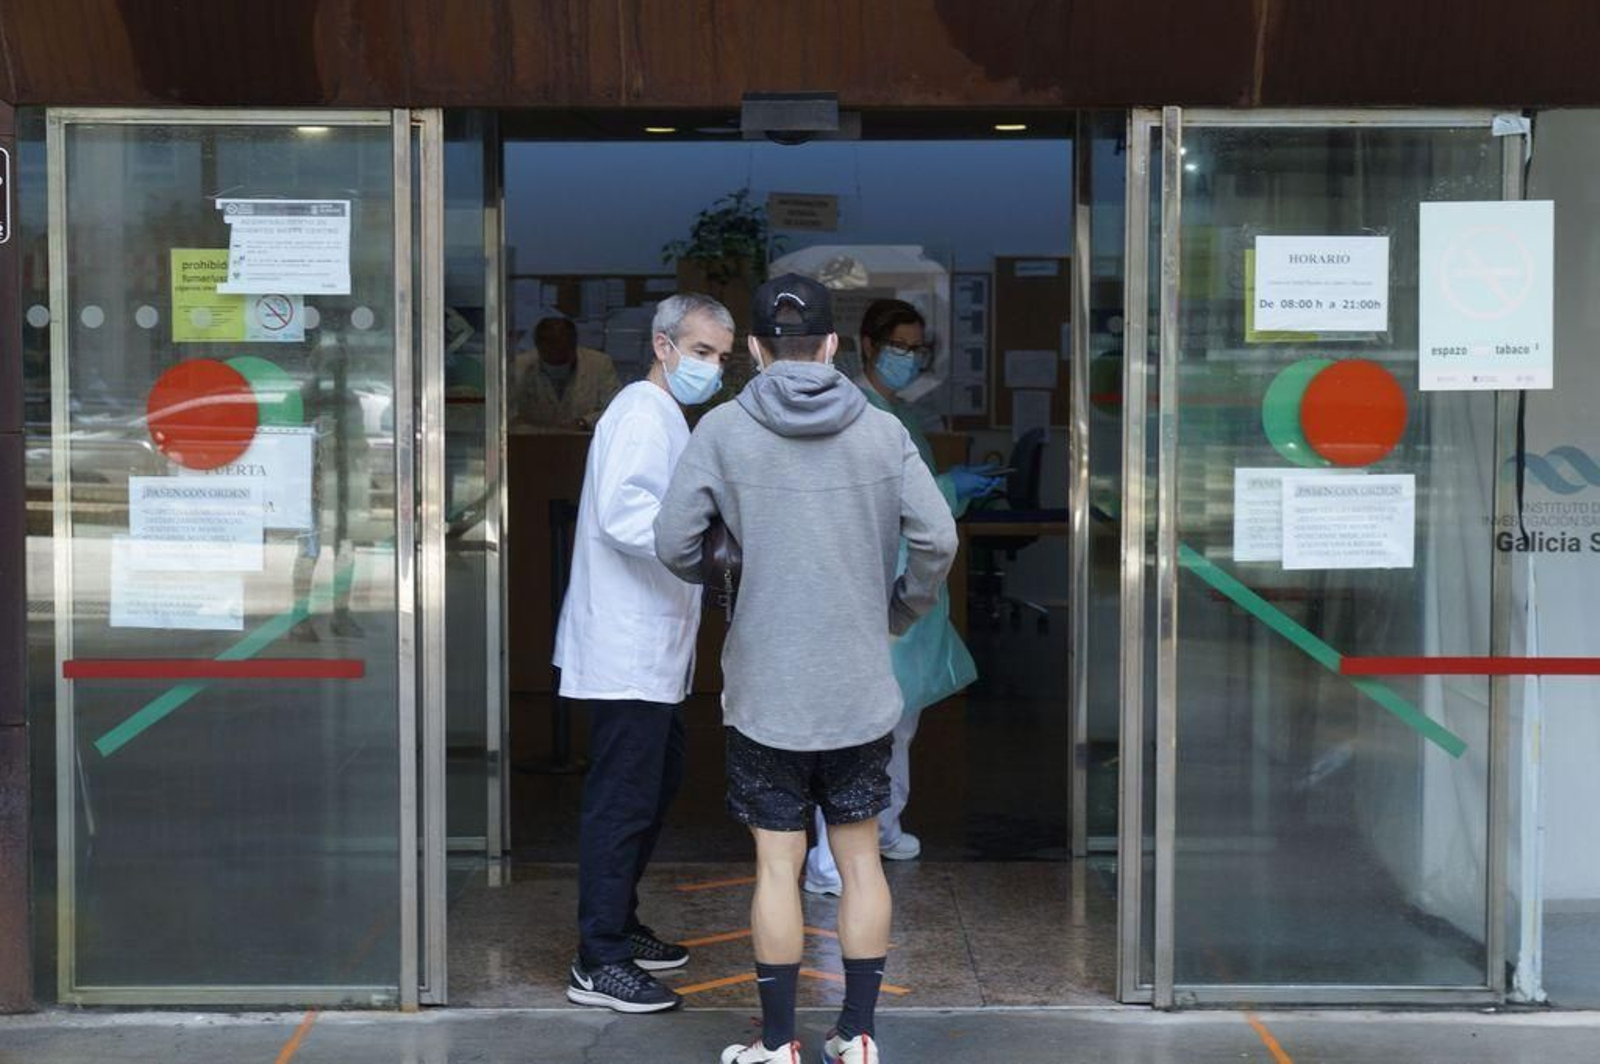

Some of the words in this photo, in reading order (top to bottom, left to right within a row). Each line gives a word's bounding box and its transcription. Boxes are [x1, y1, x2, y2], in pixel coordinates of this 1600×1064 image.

[1289, 254, 1351, 264] HORARIO
[1260, 299, 1275, 309] De
[1280, 299, 1313, 309] 08:00
[1315, 299, 1323, 309] h
[1328, 301, 1336, 309] a
[1342, 299, 1382, 310] 21:00h
[1431, 346, 1468, 358] espazo
[1494, 344, 1531, 355] tabaco
[1496, 531, 1581, 552] Galicia
